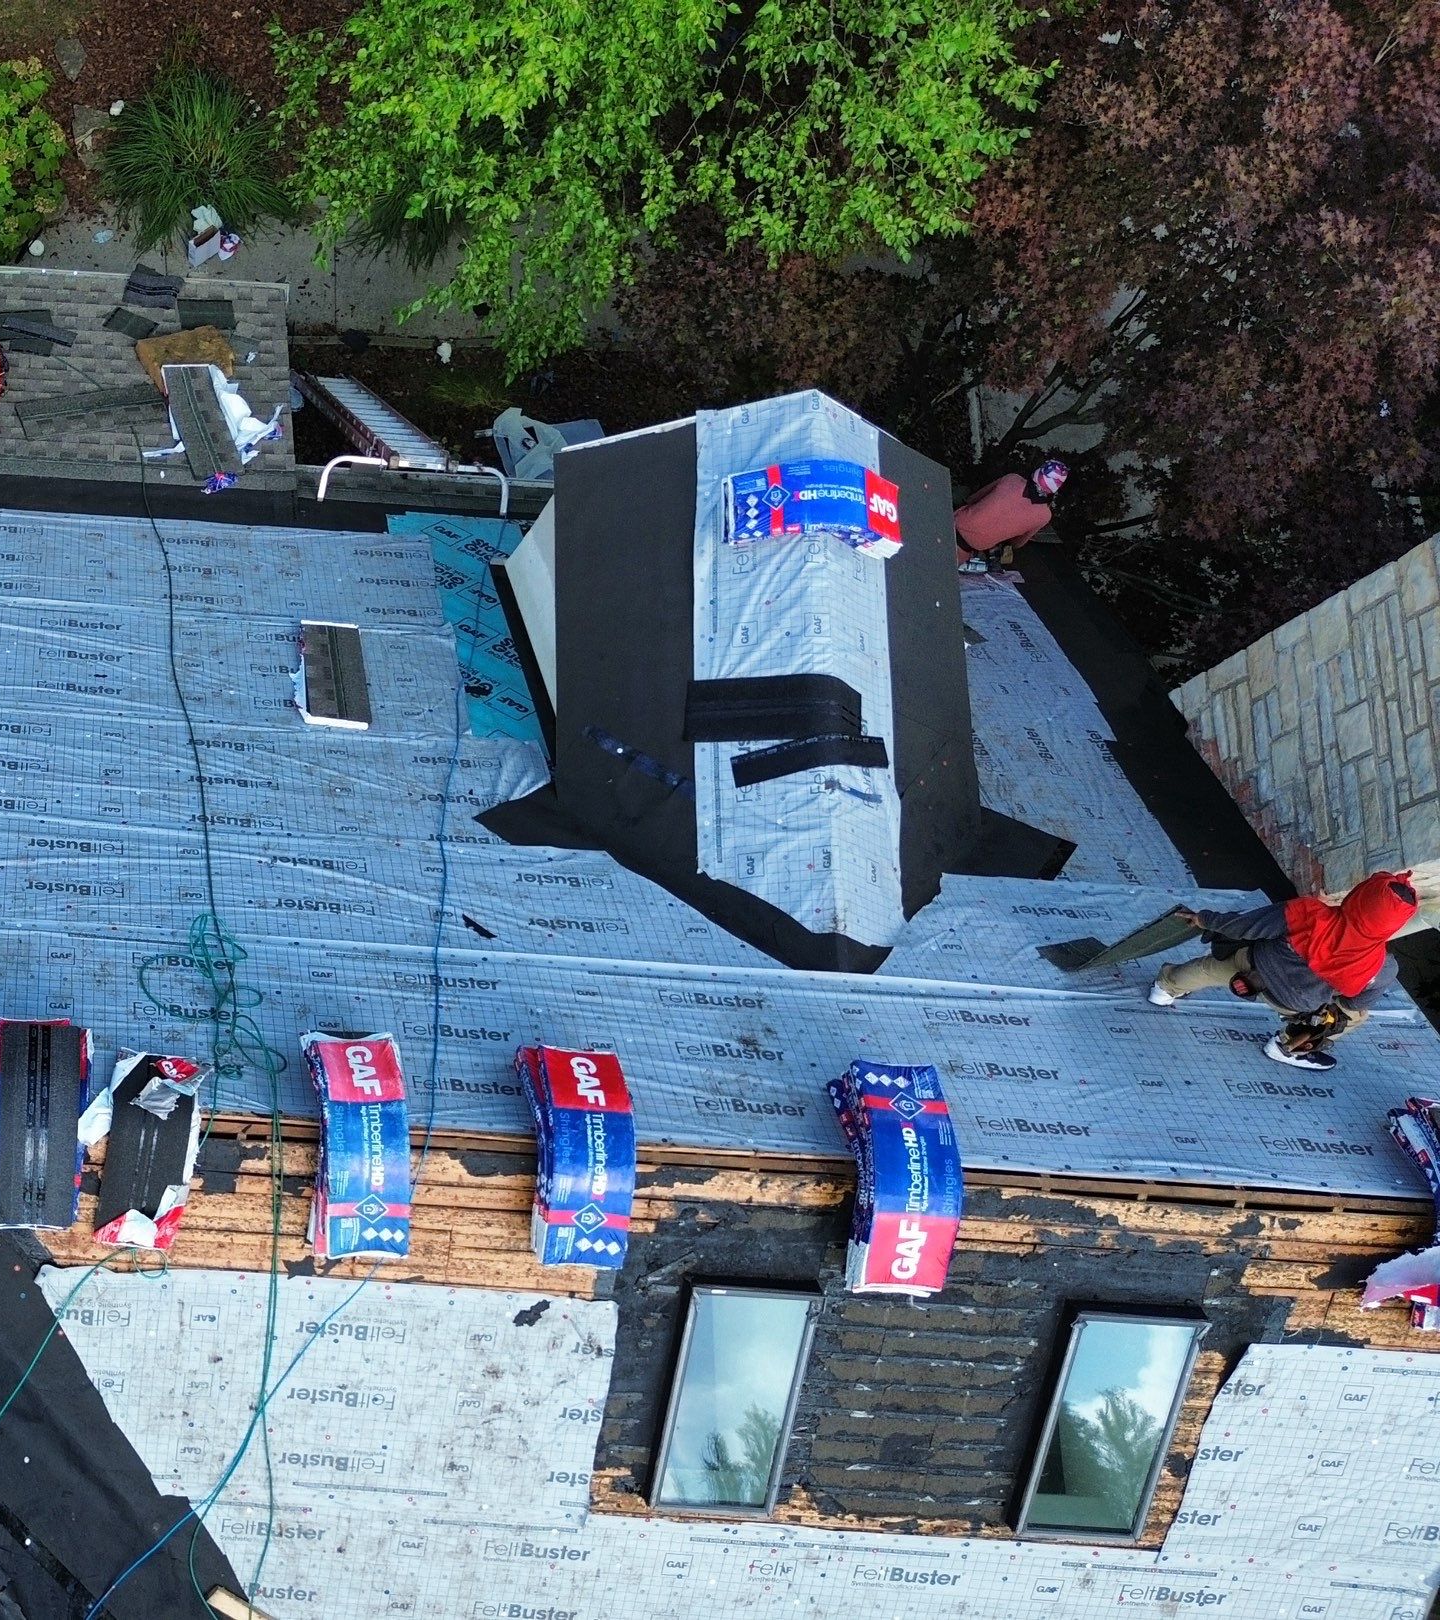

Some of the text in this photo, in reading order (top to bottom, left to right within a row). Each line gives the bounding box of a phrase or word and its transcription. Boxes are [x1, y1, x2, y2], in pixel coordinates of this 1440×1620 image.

[870, 494, 897, 523] GAF
[270, 856, 367, 873] FeltBuster
[27, 879, 124, 899] FeltBuster
[517, 872, 614, 889] FeltBuster
[275, 899, 376, 916] FeltBuster
[1012, 905, 1110, 920] FeltBuster
[528, 918, 628, 934] FeltBuster
[393, 971, 498, 992] FeltBuster
[660, 990, 764, 1010] FeltBuster
[923, 1007, 1030, 1027] FeltBuster
[402, 1022, 510, 1041] FeltBuster
[675, 1041, 784, 1063] FeltBuster
[346, 1045, 380, 1096] GAF
[947, 1059, 1058, 1080] FeltBuster
[570, 1057, 605, 1106] GAF
[1223, 1078, 1335, 1099] FeltBuster
[693, 1096, 805, 1117] FeltBuster
[977, 1117, 1091, 1137] FeltBuster
[1260, 1136, 1373, 1157] FeltBuster
[891, 1219, 928, 1279] GAF
[297, 1321, 406, 1344] FeltBuster
[287, 1388, 395, 1410] FeltBuster
[281, 1451, 385, 1474] FeltBuster
[221, 1519, 325, 1541] FeltBuster
[484, 1541, 589, 1562] FeltBuster
[853, 1566, 960, 1586] FeltBuster
[1119, 1584, 1226, 1605] FeltBuster
